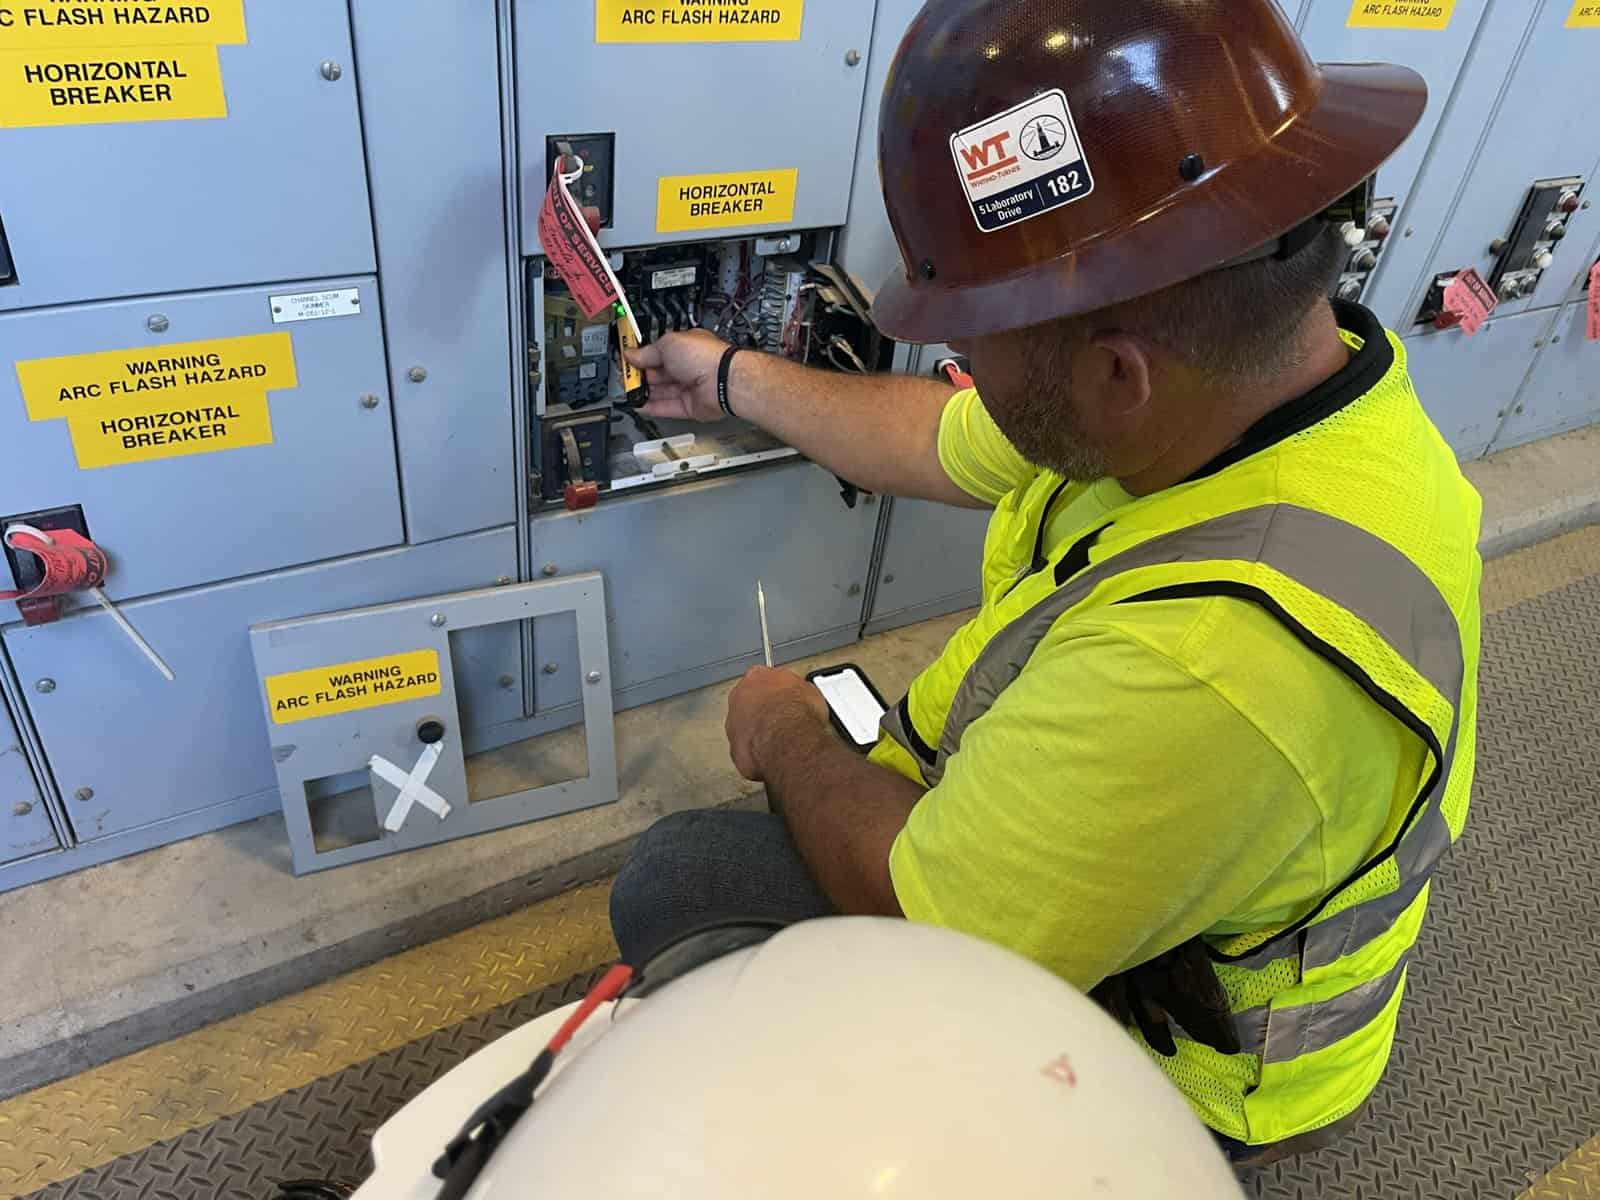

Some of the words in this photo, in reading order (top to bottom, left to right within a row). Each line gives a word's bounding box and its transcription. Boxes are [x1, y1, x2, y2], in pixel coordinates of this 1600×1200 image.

[24, 8, 104, 26] FLASH
[114, 7, 210, 24] HAZARD
[622, 10, 656, 24] ARC
[662, 10, 712, 24] FLASH
[719, 10, 781, 24] HAZARD
[1363, 4, 1381, 15] ARC
[1383, 5, 1408, 16] FLASH
[1409, 7, 1442, 17] HAZARD
[24, 60, 187, 83] HORIZONTAL
[50, 84, 172, 106] BREAKER
[960, 130, 1010, 170] WT
[679, 181, 776, 200] HORIZONTAL
[1047, 170, 1083, 197] 182
[690, 198, 764, 216] BREAKER
[979, 204, 987, 215] 5
[985, 189, 1033, 213] Laboratory
[997, 206, 1022, 221] Drive
[572, 233, 613, 295] SERVICE
[127, 353, 221, 376] WARNING
[58, 384, 101, 401] ARC
[110, 375, 177, 395] FLASH
[185, 364, 267, 385] HAZARD
[101, 405, 240, 435] HORIZONTAL
[122, 423, 227, 449] BREAKER
[329, 665, 401, 687] WARNING
[276, 695, 309, 711] ARC
[315, 685, 367, 703] FLASH
[374, 672, 437, 693] HAZARD
